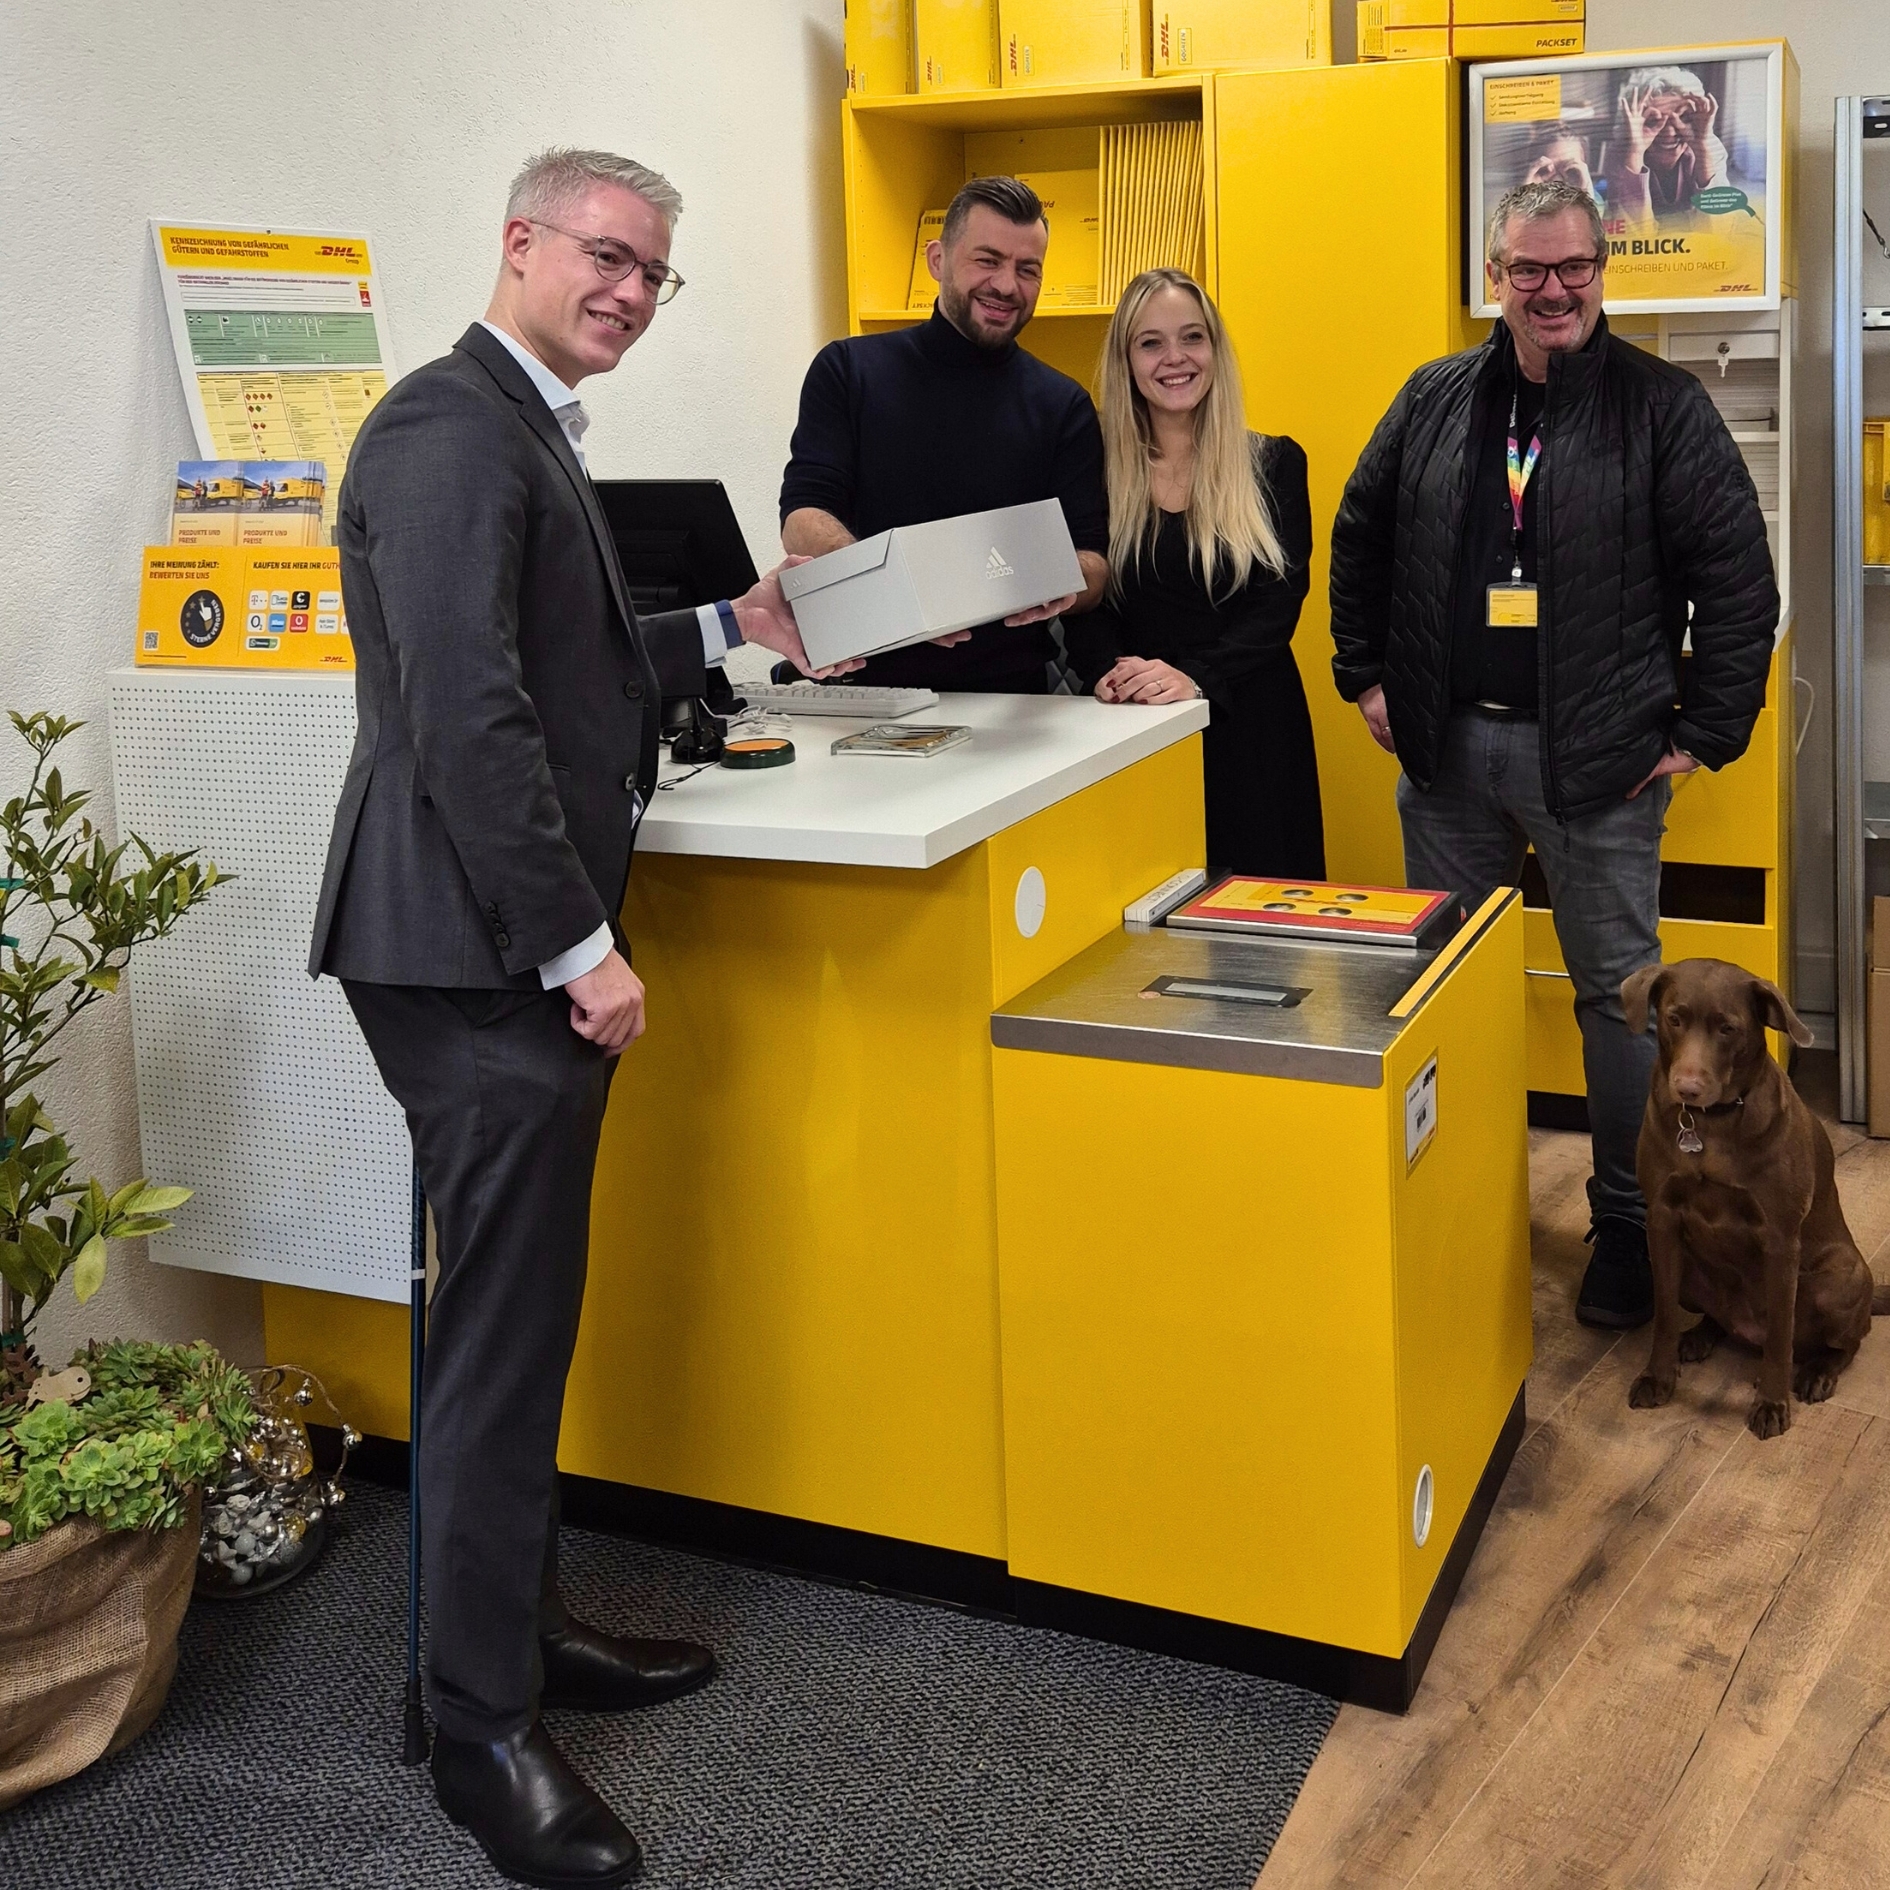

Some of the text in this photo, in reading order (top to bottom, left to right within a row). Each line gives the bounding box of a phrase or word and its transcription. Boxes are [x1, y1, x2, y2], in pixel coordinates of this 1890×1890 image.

[1161, 21, 1169, 60] DHL
[1536, 38, 1577, 47] PACKSET
[1603, 219, 1625, 234] NE
[170, 237, 289, 250] KENNZEICHNUNG VON GEFÄHRLICHEN
[1632, 238, 1691, 255] BLICK.
[172, 245, 269, 258] GÜTERN UND GEFAHRSTOFFEN
[320, 245, 356, 257] DHL
[1673, 262, 1694, 272] UND
[1697, 261, 1728, 270] PAKET.
[1718, 284, 1754, 292] DHL
[197, 559, 219, 568] ZÄHLT:
[149, 571, 183, 579] BEWERTEN
[986, 566, 1014, 580] adidas
